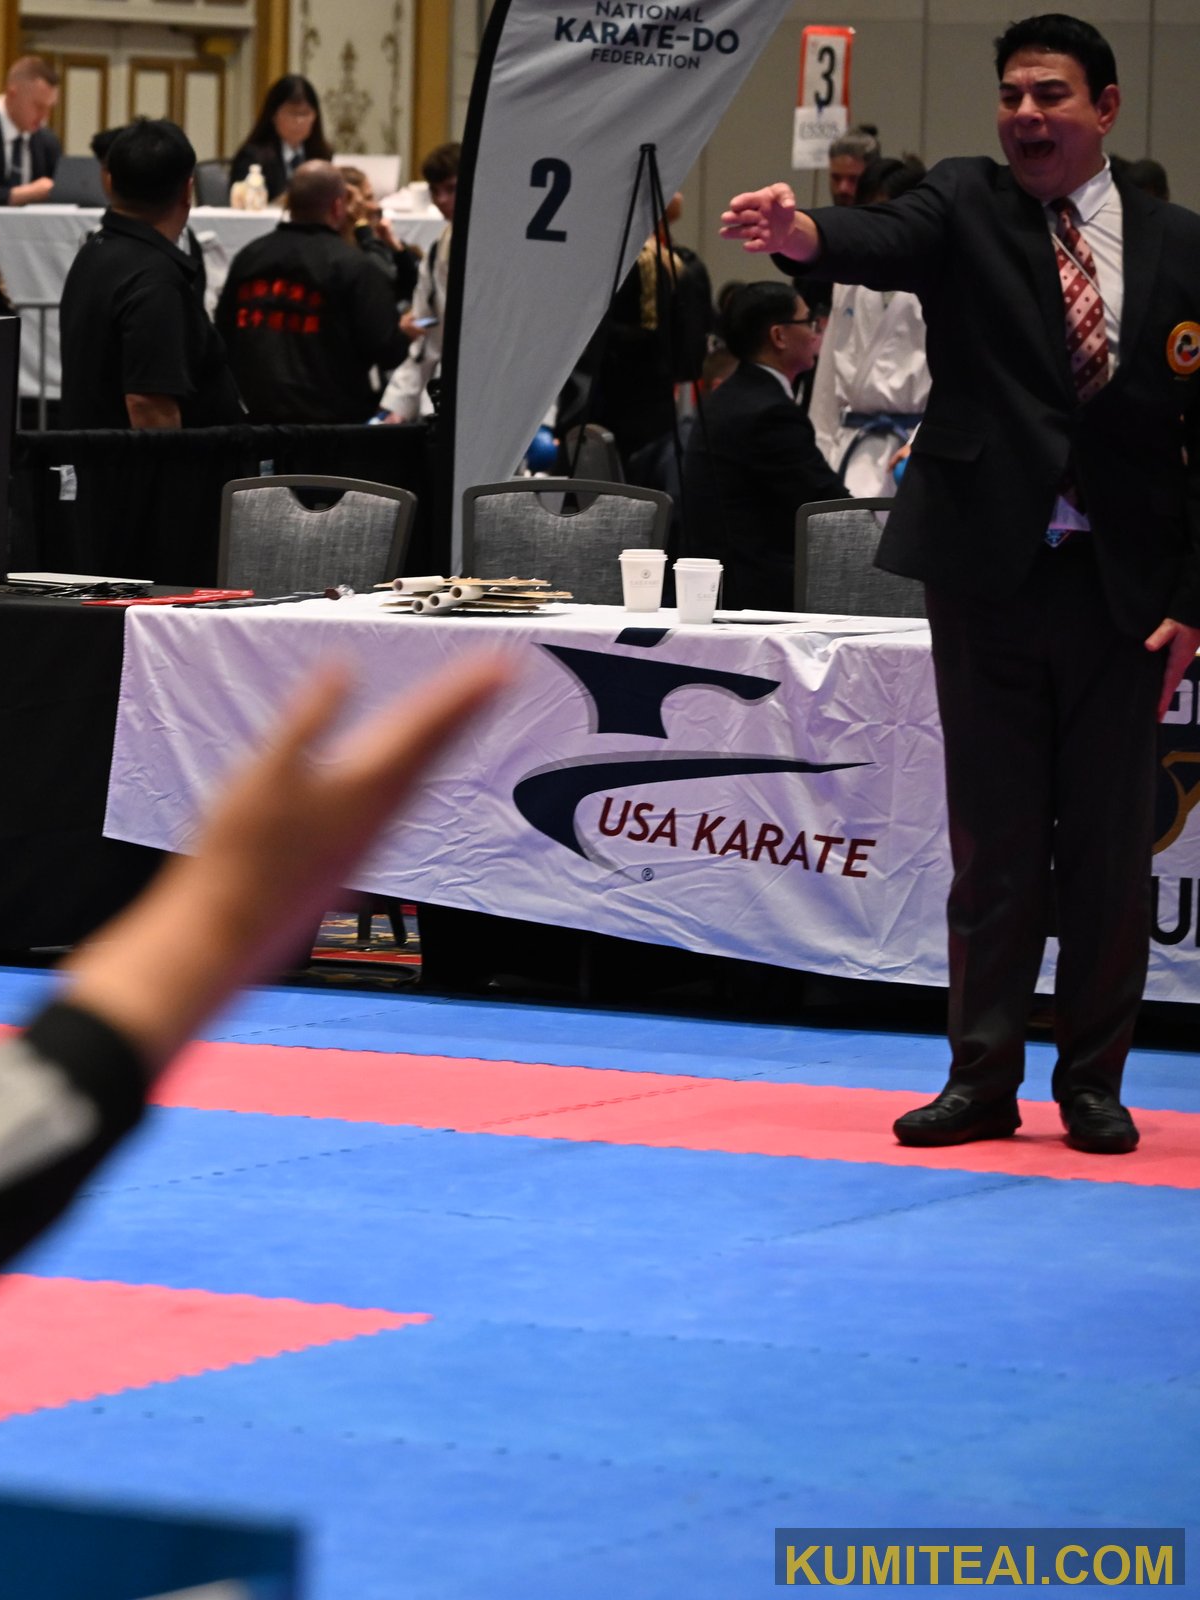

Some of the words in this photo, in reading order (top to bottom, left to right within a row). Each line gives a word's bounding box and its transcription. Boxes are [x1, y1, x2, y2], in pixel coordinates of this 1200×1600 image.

[554, 16, 739, 54] KARATE-DO
[595, 1, 703, 24] NATIONAL
[590, 48, 700, 69] FEDERATION
[814, 45, 835, 107] 3
[525, 157, 571, 243] 2
[598, 797, 677, 847] USA
[691, 813, 877, 878] KARATE
